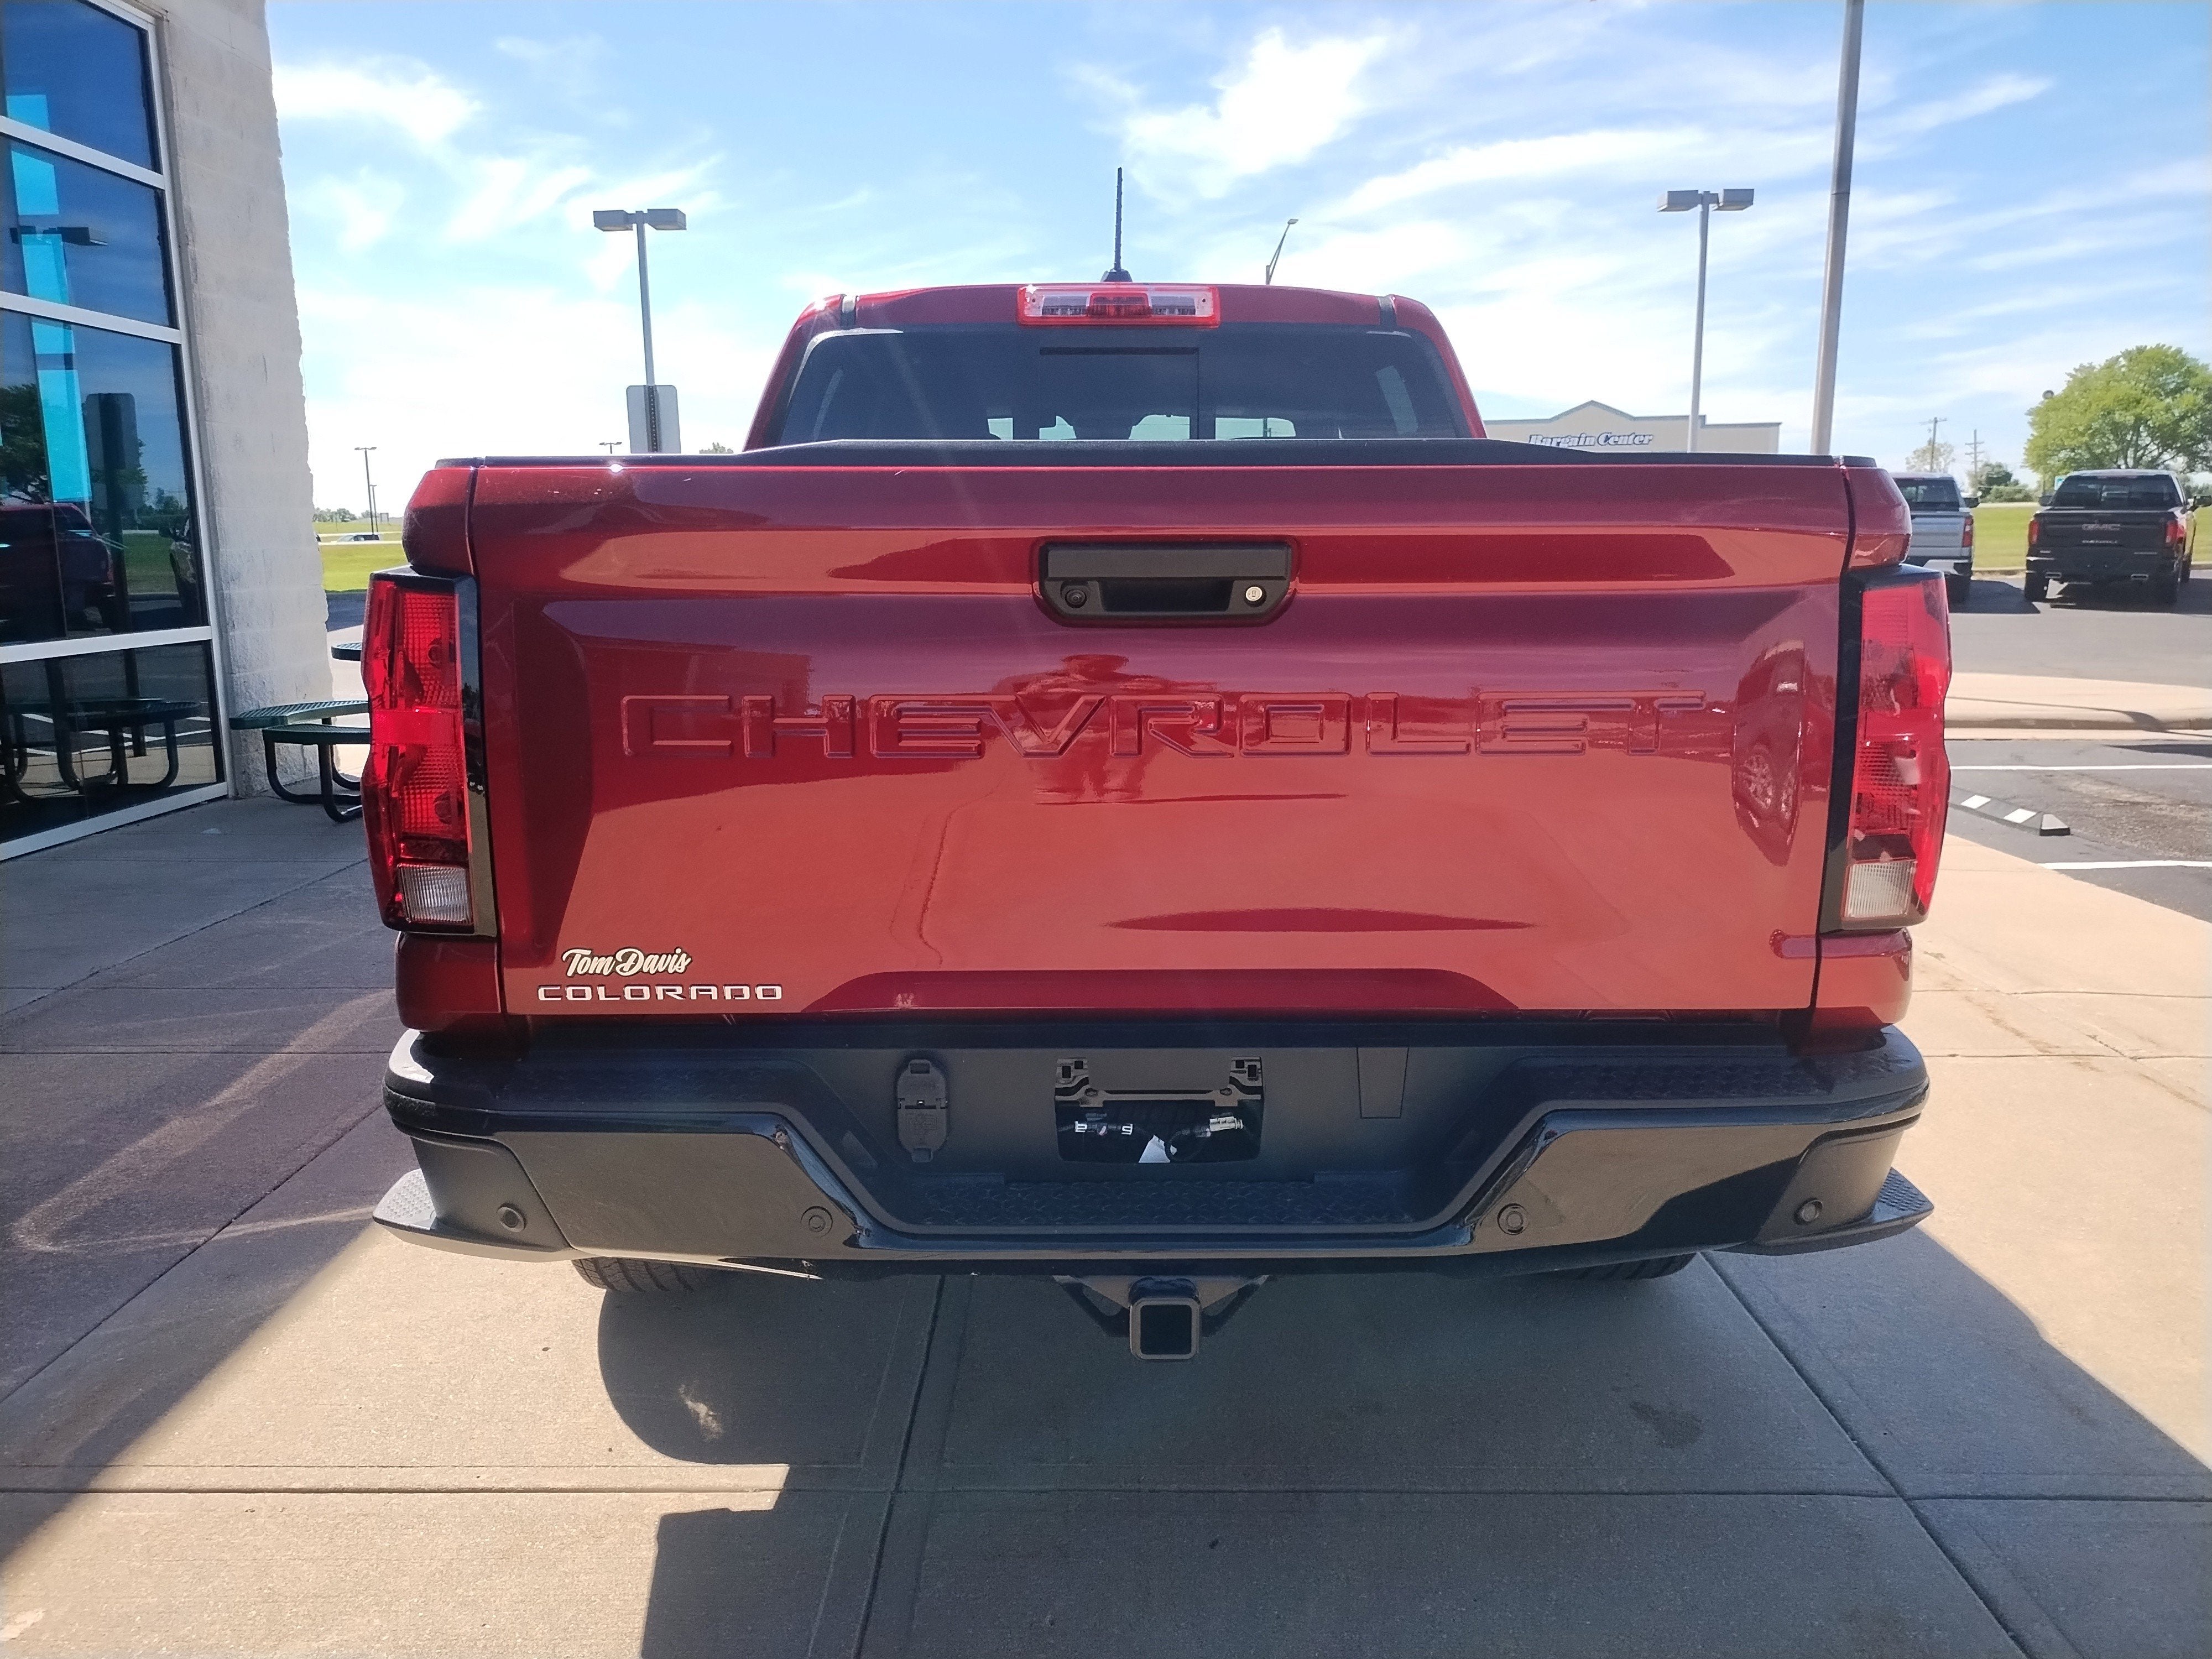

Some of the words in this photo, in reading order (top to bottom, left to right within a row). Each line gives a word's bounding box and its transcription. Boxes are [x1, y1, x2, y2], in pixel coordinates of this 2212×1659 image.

[1528, 432, 1595, 447] Bargain
[1598, 432, 1653, 446] Center
[621, 690, 1706, 758] CHEVROLET
[561, 946, 615, 977] Tom
[615, 946, 692, 977] Davis
[538, 985, 782, 1001] COLORADO
